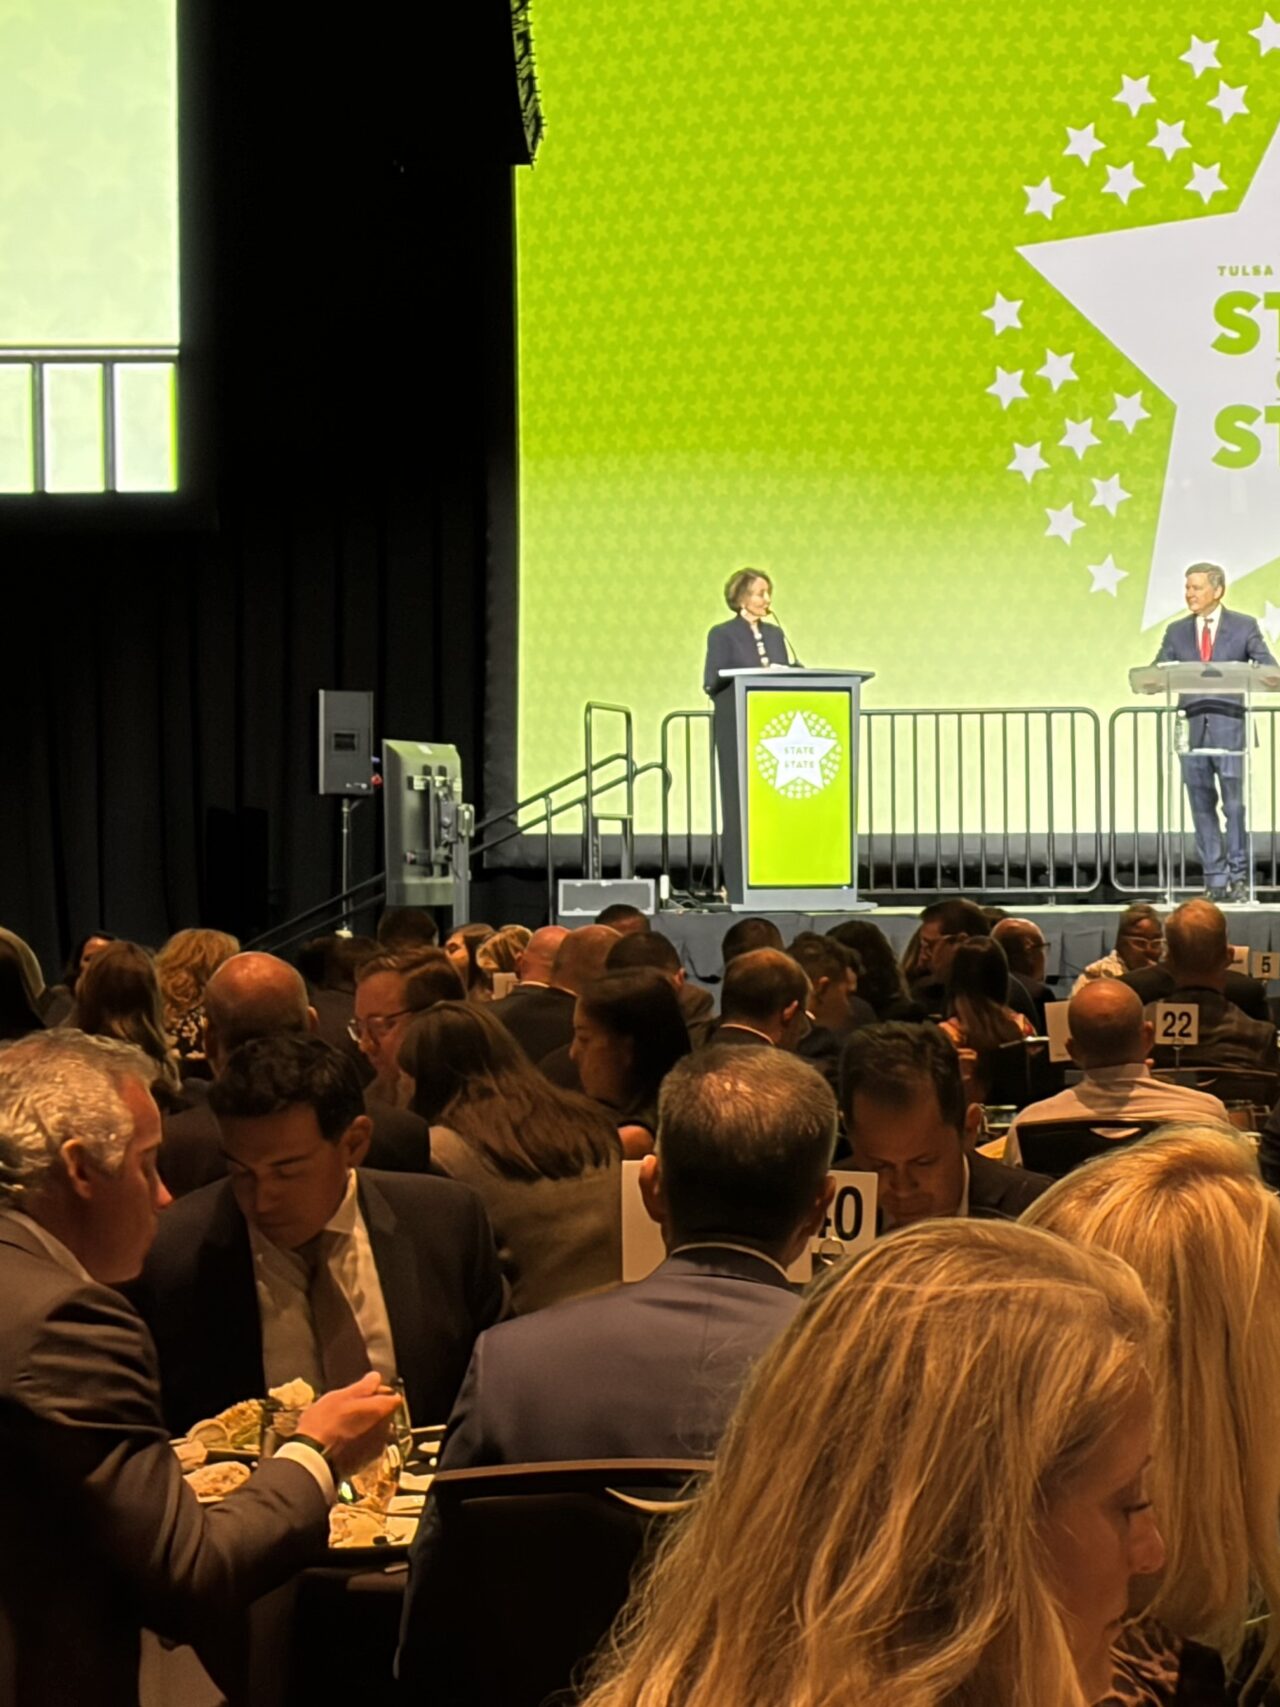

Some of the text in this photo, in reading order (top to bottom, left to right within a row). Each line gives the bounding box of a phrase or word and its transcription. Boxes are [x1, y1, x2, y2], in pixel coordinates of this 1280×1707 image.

[1217, 264, 1274, 277] TULSA
[784, 746, 815, 755] STATE
[784, 760, 815, 769] STATE
[1261, 955, 1271, 973] 5
[1162, 1011, 1192, 1038] 22
